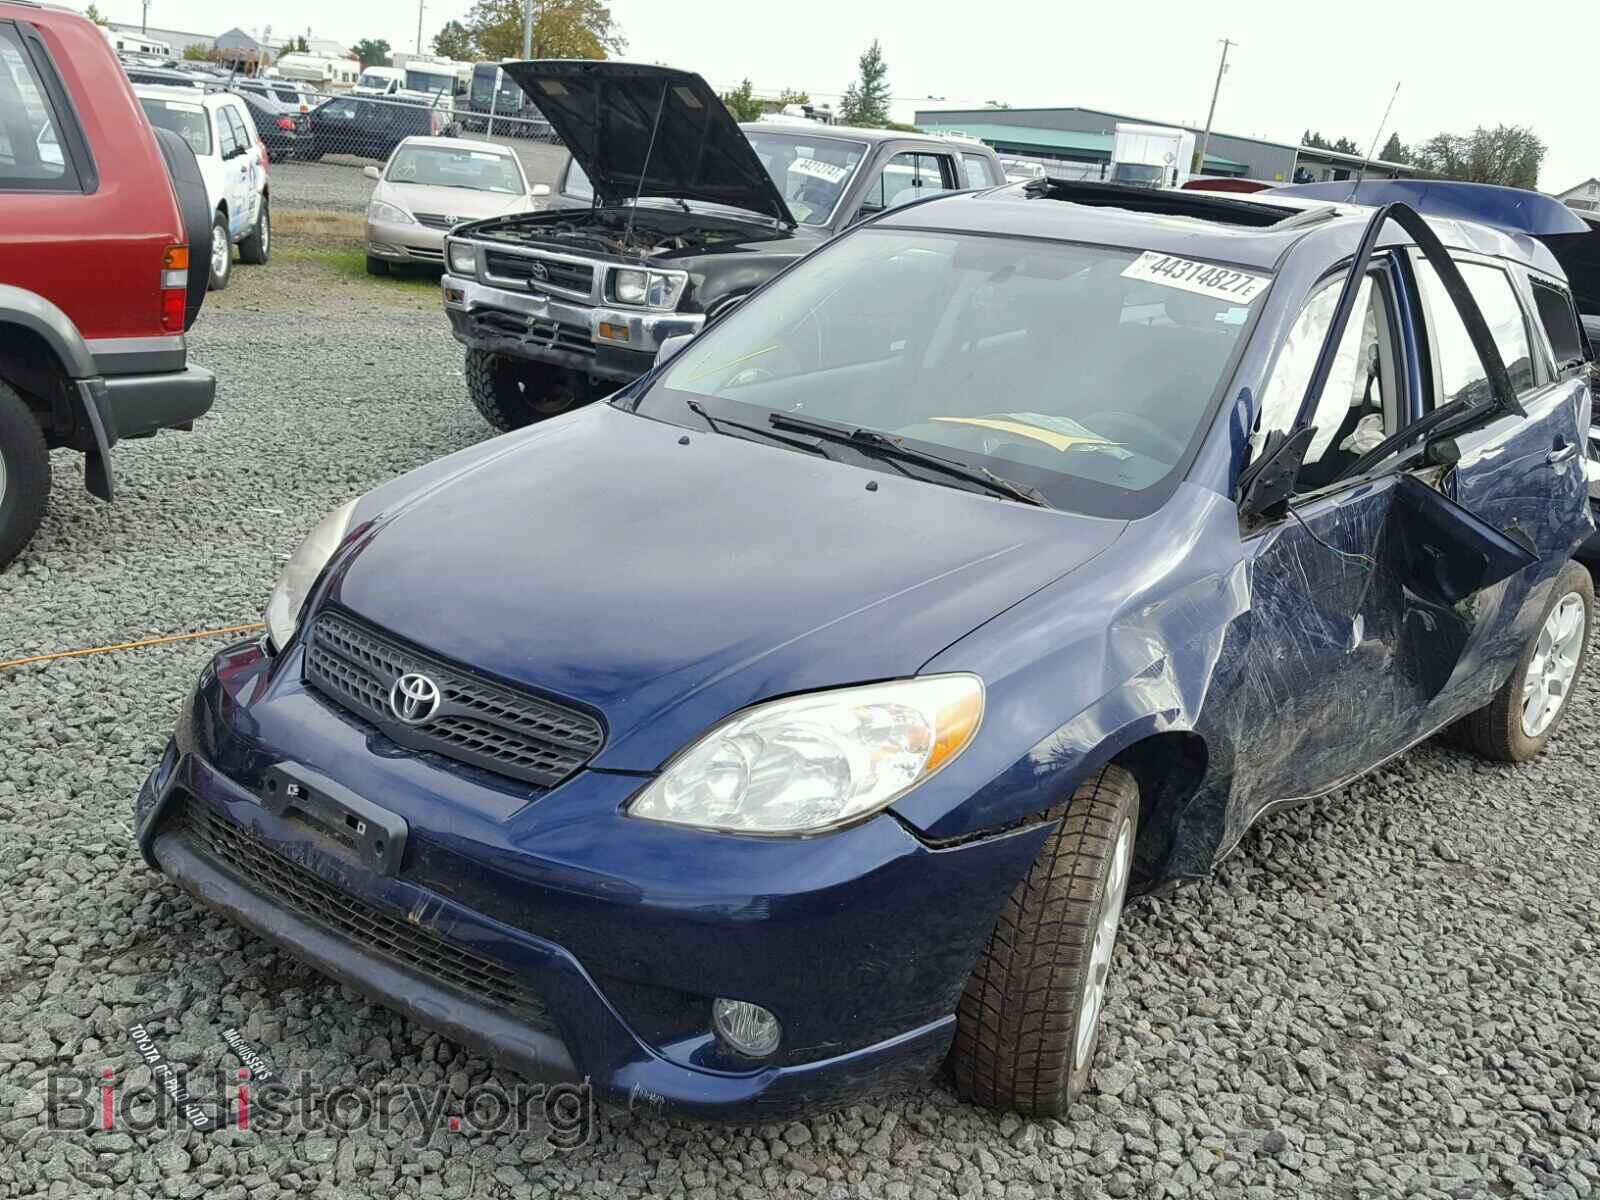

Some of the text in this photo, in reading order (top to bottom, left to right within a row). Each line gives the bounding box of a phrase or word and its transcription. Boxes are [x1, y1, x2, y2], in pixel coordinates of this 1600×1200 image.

[1149, 256, 1255, 293] 44314827
[221, 1027, 273, 1081] MAGNUSSEN'S
[163, 1074, 190, 1103] PALO
[182, 1103, 209, 1127] ALTO
